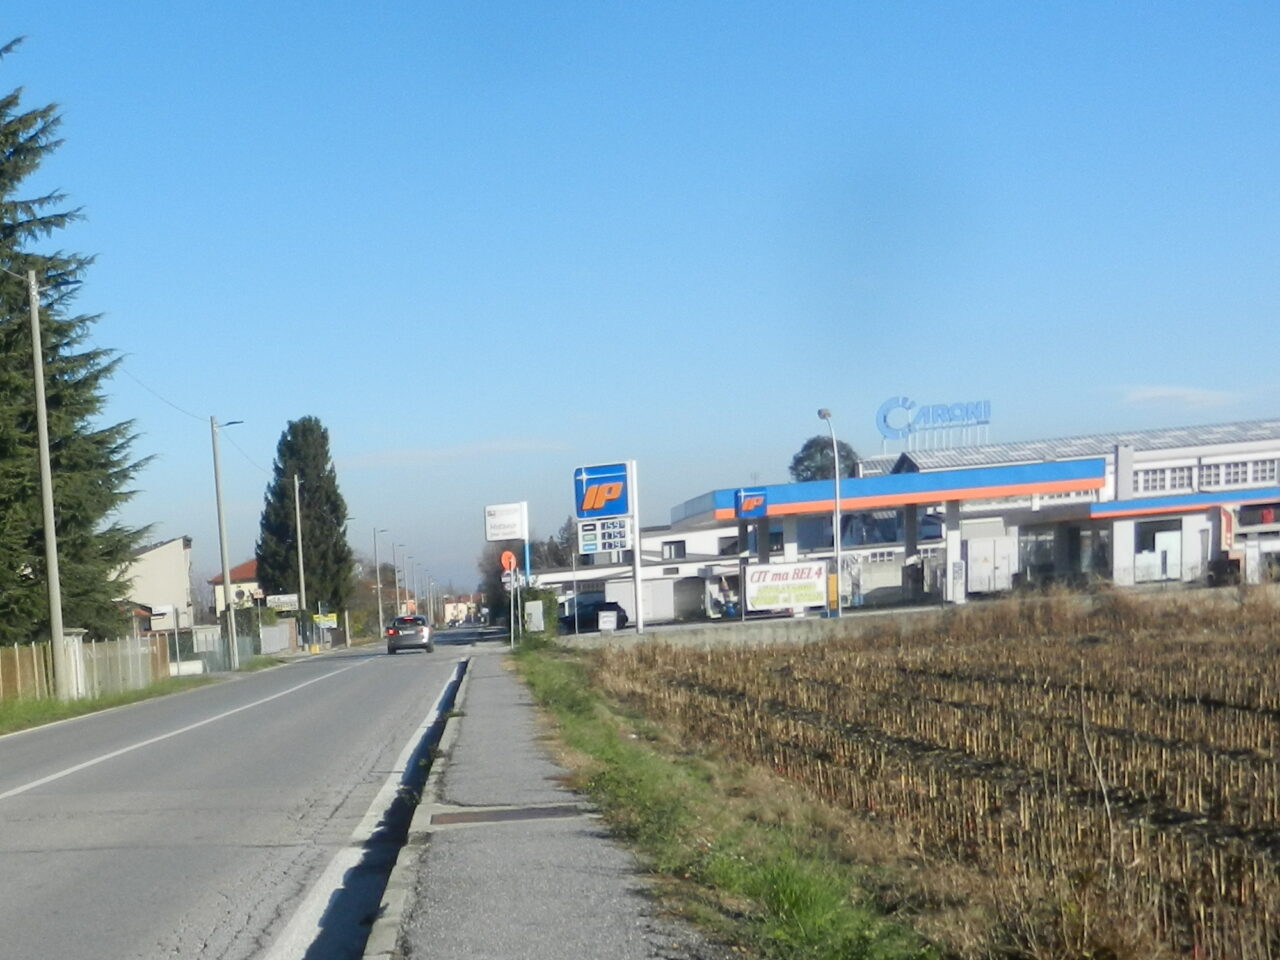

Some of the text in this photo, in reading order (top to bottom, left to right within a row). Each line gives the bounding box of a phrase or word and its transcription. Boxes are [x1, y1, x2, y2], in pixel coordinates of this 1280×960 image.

[876, 397, 991, 439] CARONI
[582, 483, 622, 510] IP
[742, 496, 763, 510] IP
